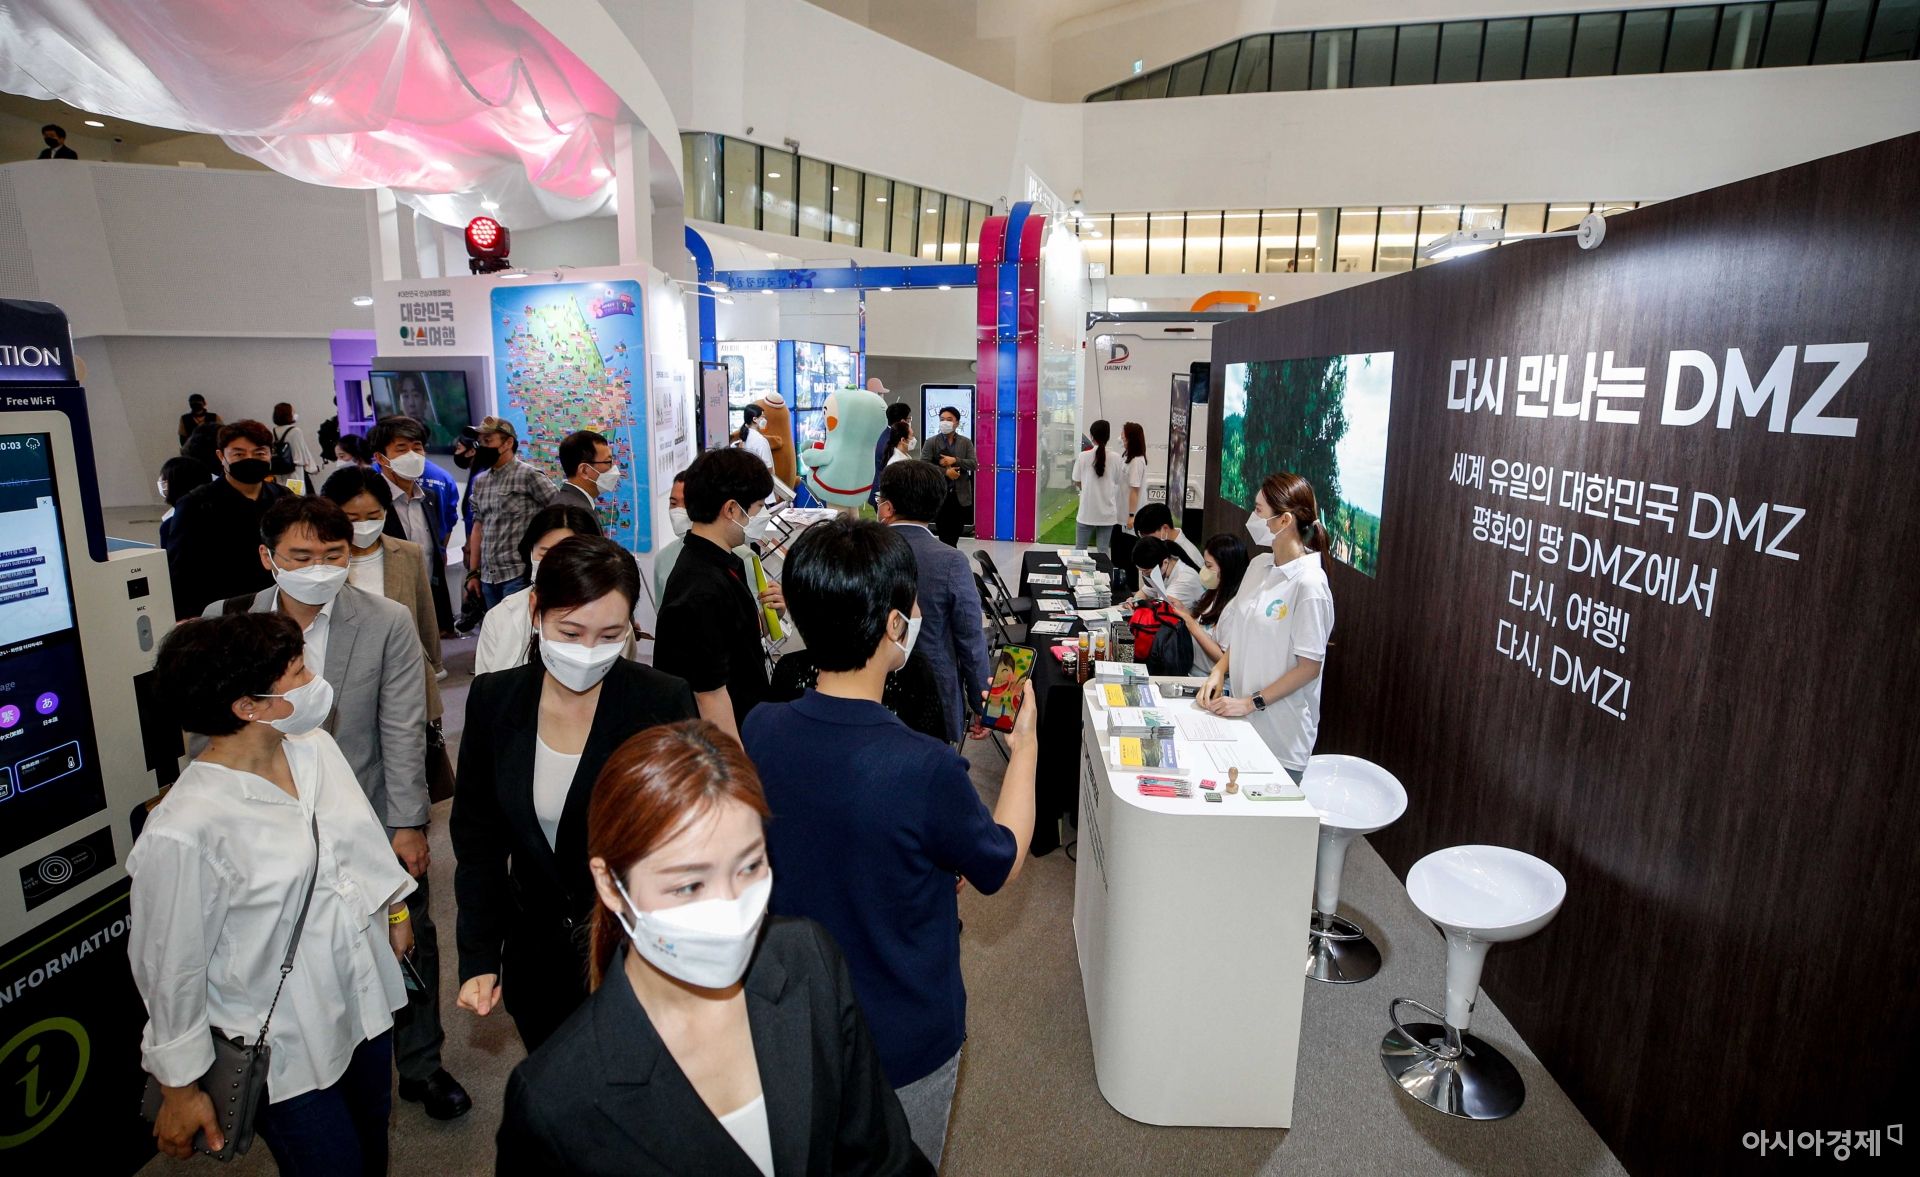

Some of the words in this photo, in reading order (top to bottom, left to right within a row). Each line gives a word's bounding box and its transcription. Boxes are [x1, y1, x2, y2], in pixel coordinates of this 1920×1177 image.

[400, 301, 454, 322] 대한민국
[399, 325, 456, 346] 안심여행
[0, 344, 61, 367] TION
[6, 397, 29, 406] Free
[30, 396, 56, 406] Wi-Fi
[1447, 356, 1508, 415] 다시
[1515, 350, 1646, 425] 만나는
[1660, 342, 1870, 438] DMZ
[0, 441, 22, 451] 0:03
[1151, 489, 1167, 499] 702
[1449, 452, 1485, 491] 세계
[1488, 458, 1554, 506] 유일의
[1559, 470, 1679, 534] 대한민국
[1688, 492, 1806, 561] DMZ
[1472, 505, 1533, 556] 평화의
[1538, 523, 1565, 565] 땅
[1567, 532, 1718, 618] DMZ에서
[1508, 570, 1557, 628] 다시,
[1565, 593, 1631, 654] 여행!
[1496, 618, 1543, 680] 다시,
[1549, 644, 1632, 721] DMZ!
[42, 698, 53, 709] あ
